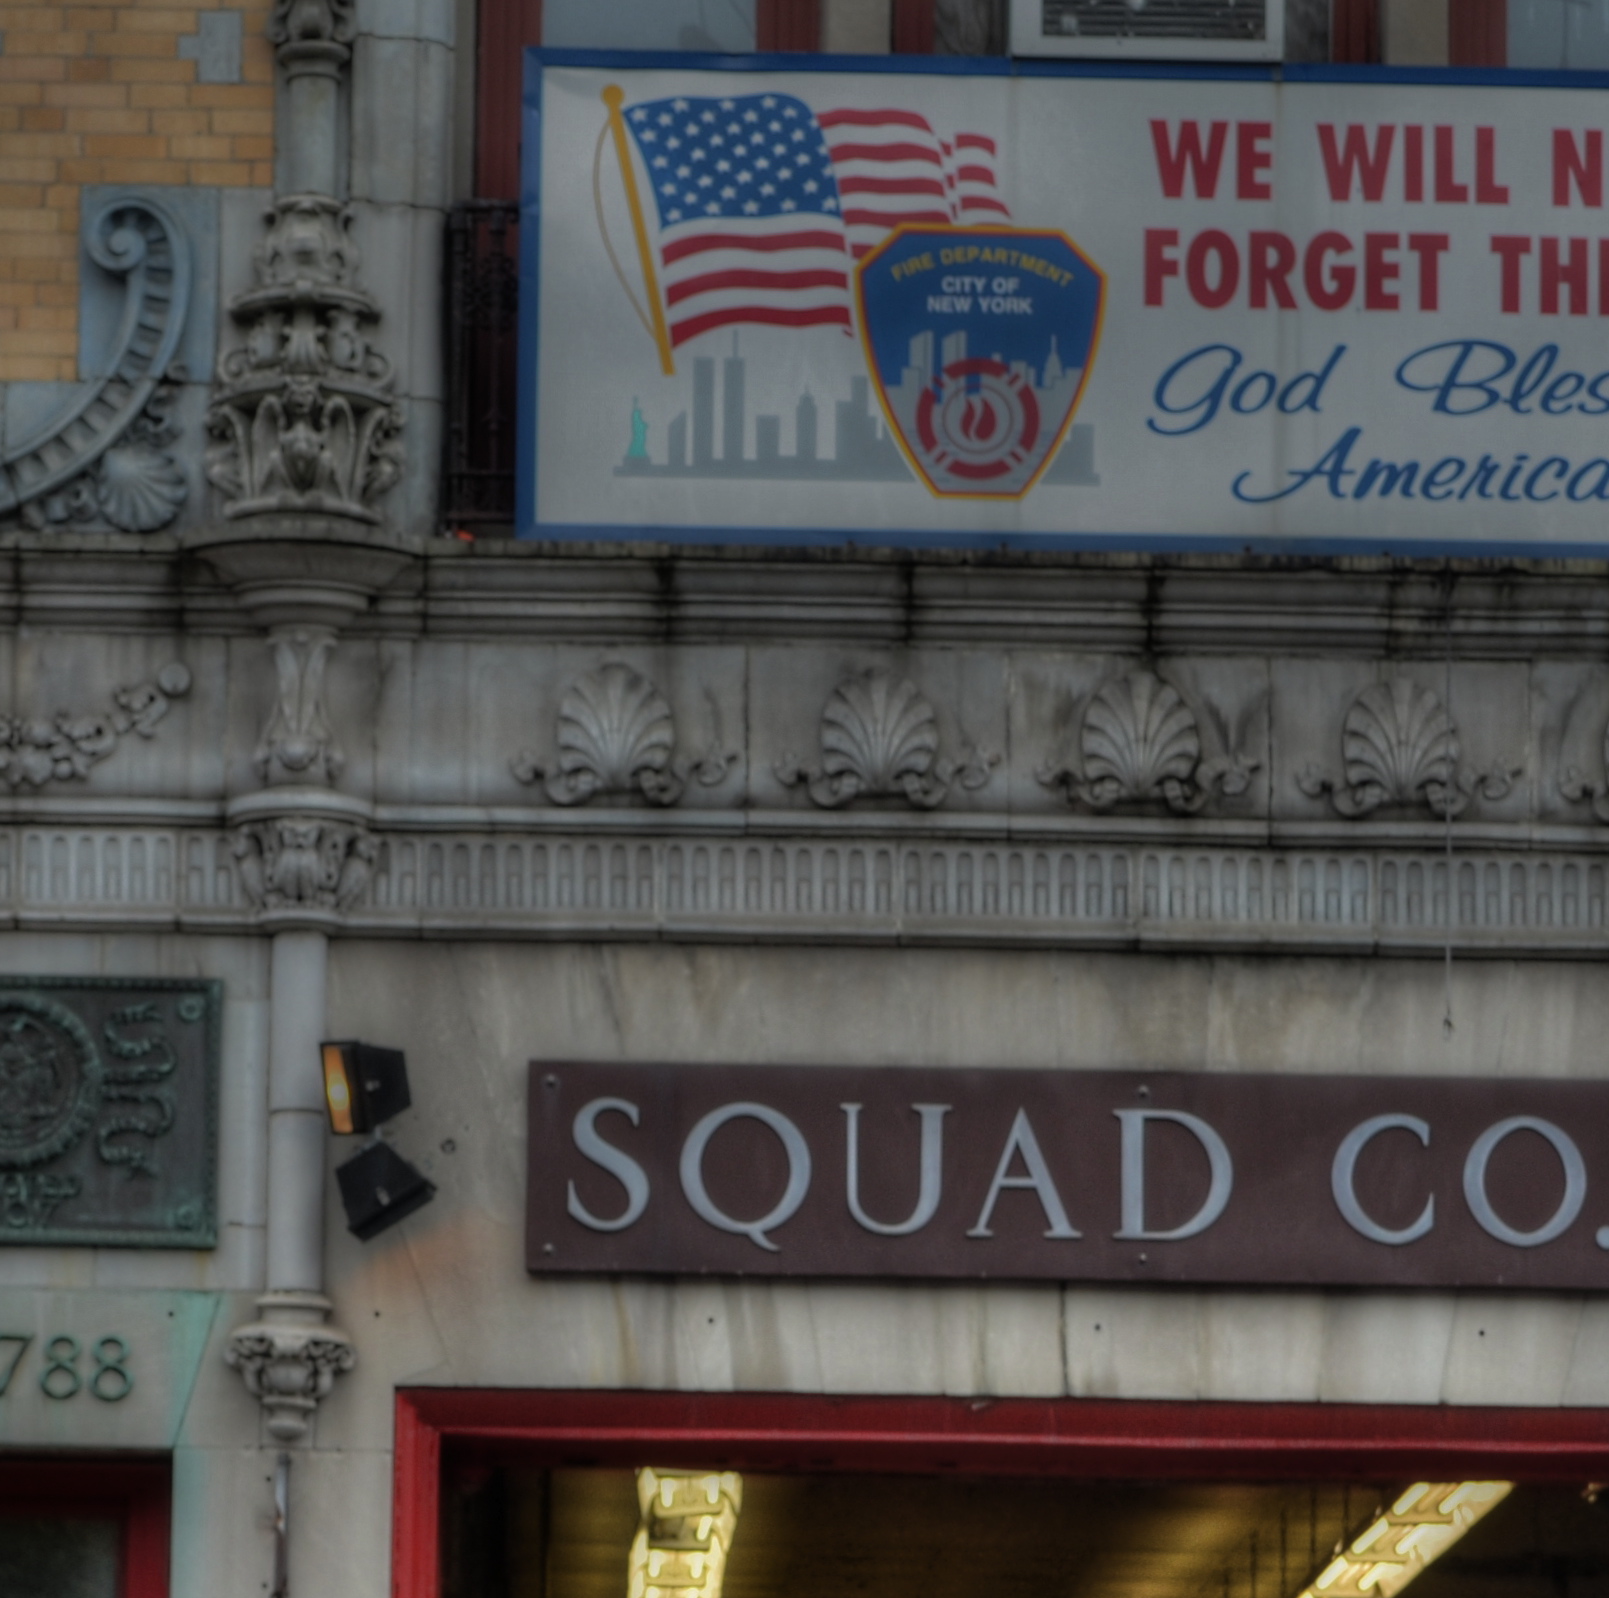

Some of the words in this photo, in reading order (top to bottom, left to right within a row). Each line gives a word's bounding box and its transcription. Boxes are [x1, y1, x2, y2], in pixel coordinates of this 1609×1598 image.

[1148, 119, 1273, 202] WE
[1316, 123, 1510, 205] WILL
[890, 251, 937, 282] FIRE
[940, 245, 1075, 287] DEPARTMENT
[926, 296, 973, 314] NEW
[978, 297, 1034, 315] YORK
[942, 276, 987, 295] CITY
[991, 277, 1020, 294] OF
[1142, 227, 1450, 314] FORGET
[1146, 342, 1349, 436] God
[565, 1095, 1235, 1253] SQUAD
